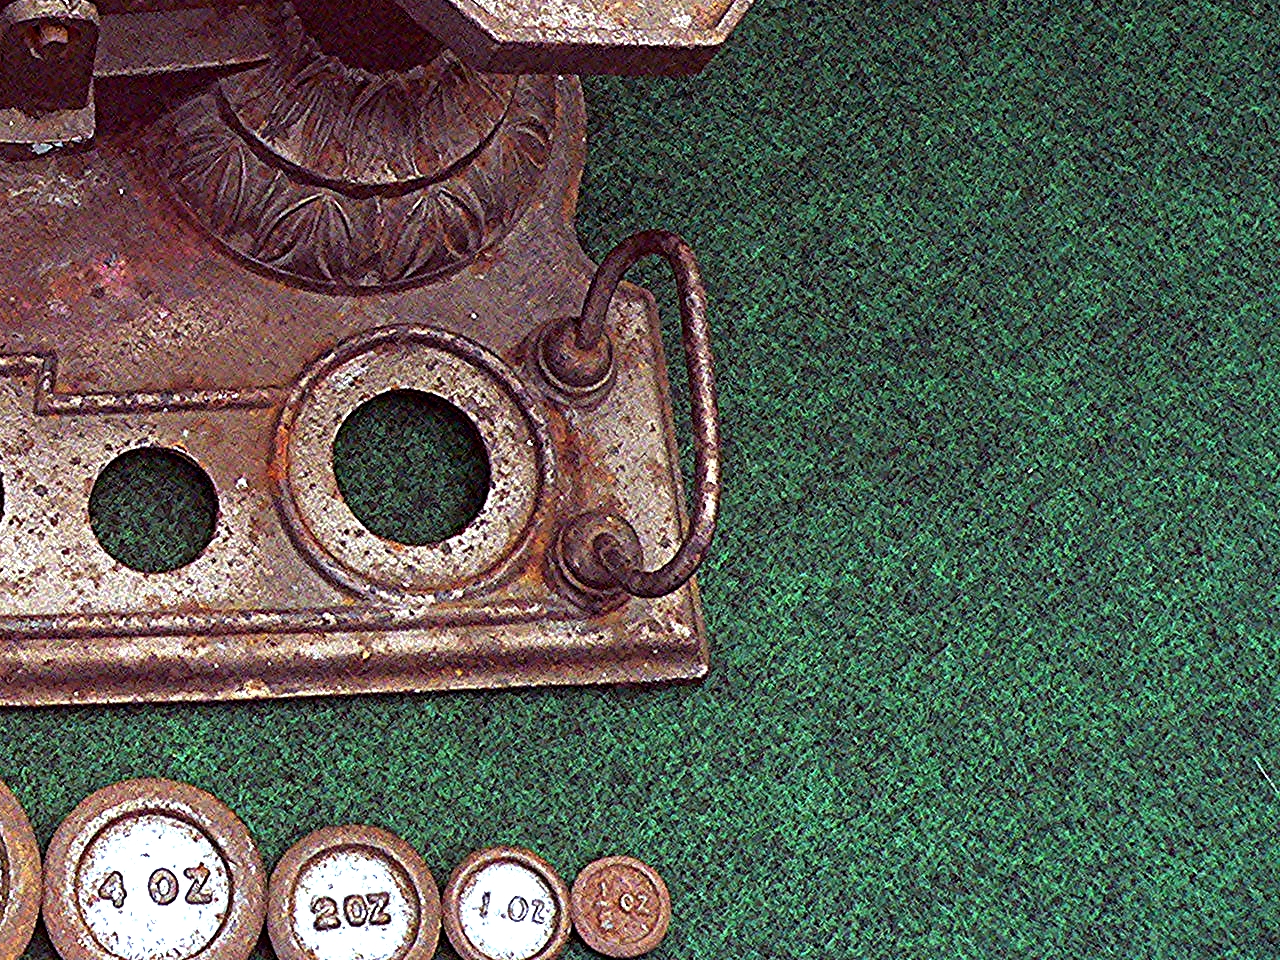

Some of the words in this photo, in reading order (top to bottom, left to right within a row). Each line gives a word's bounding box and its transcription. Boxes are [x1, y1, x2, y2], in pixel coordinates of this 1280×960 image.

[98, 870, 127, 908] 4
[147, 863, 213, 905] OZ
[620, 893, 650, 913] OZ
